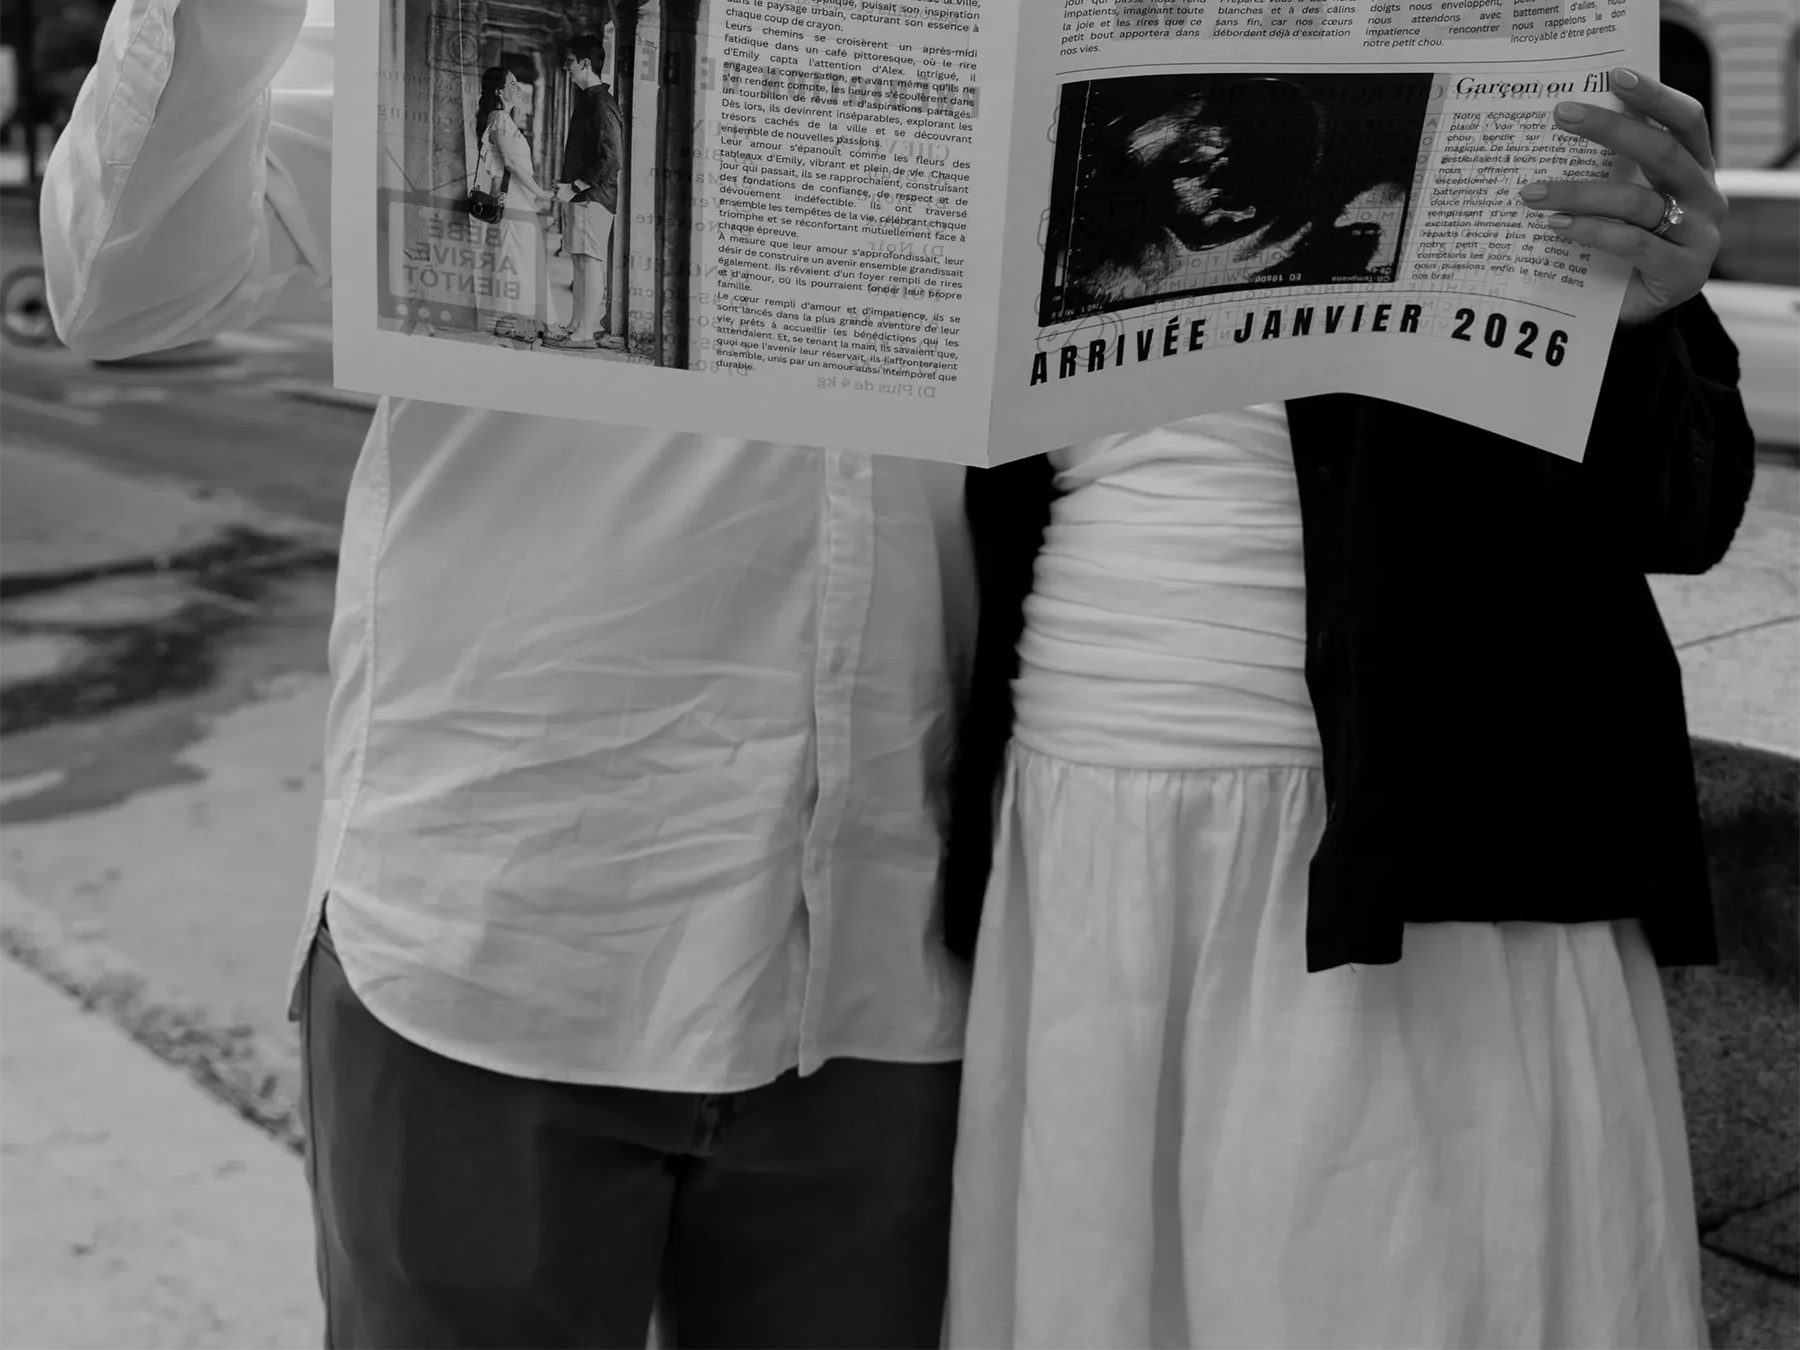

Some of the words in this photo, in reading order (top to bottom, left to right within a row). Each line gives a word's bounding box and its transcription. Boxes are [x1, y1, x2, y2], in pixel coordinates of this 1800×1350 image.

[725, 6, 762, 21] chaque
[763, 13, 789, 27] coup
[790, 15, 804, 27] de
[805, 19, 843, 32] crayon.
[724, 19, 752, 33] Leurs
[761, 25, 804, 40] chemins
[813, 33, 826, 43] se
[835, 35, 888, 49] croisèrent
[898, 43, 912, 52] un
[922, 44, 977, 58] après-midi
[1362, 36, 1390, 47] notre
[1391, 36, 1416, 49] petit
[1417, 36, 1444, 46] chou.
[1509, 29, 1558, 43] incroyable
[1559, 27, 1585, 39] d'être
[1585, 23, 1617, 38] parents.
[1059, 46, 1077, 55] nos
[1079, 43, 1101, 54] vies.
[1456, 76, 1540, 98] Garçon
[1546, 80, 1574, 94] ou
[1583, 71, 1611, 93] fill
[721, 96, 740, 109] Dès
[743, 99, 766, 113] lors,
[768, 101, 780, 113] ils
[783, 103, 832, 118] devinrent
[835, 108, 903, 126] inséparables,
[905, 116, 955, 129] explorant
[958, 119, 973, 131] les
[1452, 110, 1481, 119] Notre
[1485, 110, 1546, 121] échographie
[719, 124, 769, 137] ensemble
[770, 127, 784, 139] de
[785, 131, 834, 143] nouvelles
[835, 135, 882, 147] passions.
[1437, 167, 1462, 175] nous
[1477, 165, 1519, 175] offraient
[1562, 167, 1609, 178] spectacle
[716, 220, 754, 234] chaque
[755, 223, 799, 238] épreuve.
[717, 244, 742, 257] désir
[743, 247, 757, 258] de
[758, 250, 809, 263] construire
[810, 256, 824, 265] un
[825, 256, 857, 268] avenir
[858, 260, 907, 272] ensemble
[908, 263, 963, 277] grandissait
[1415, 249, 1466, 260] comptions
[1469, 249, 1484, 260] les
[1486, 250, 1512, 262] jours
[1513, 253, 1549, 266] jusqu'à
[1552, 260, 1565, 269] ce
[1567, 262, 1587, 273] que
[1419, 239, 1446, 249] notre
[1455, 239, 1478, 250] petit
[1487, 240, 1512, 251] bout
[1520, 242, 1534, 252] de
[1543, 245, 1569, 257] chou
[1579, 250, 1590, 260] et
[1029, 314, 1208, 387] ARRIVÉE
[1233, 302, 1422, 343] JANVIER
[1450, 306, 1569, 368] 2026
